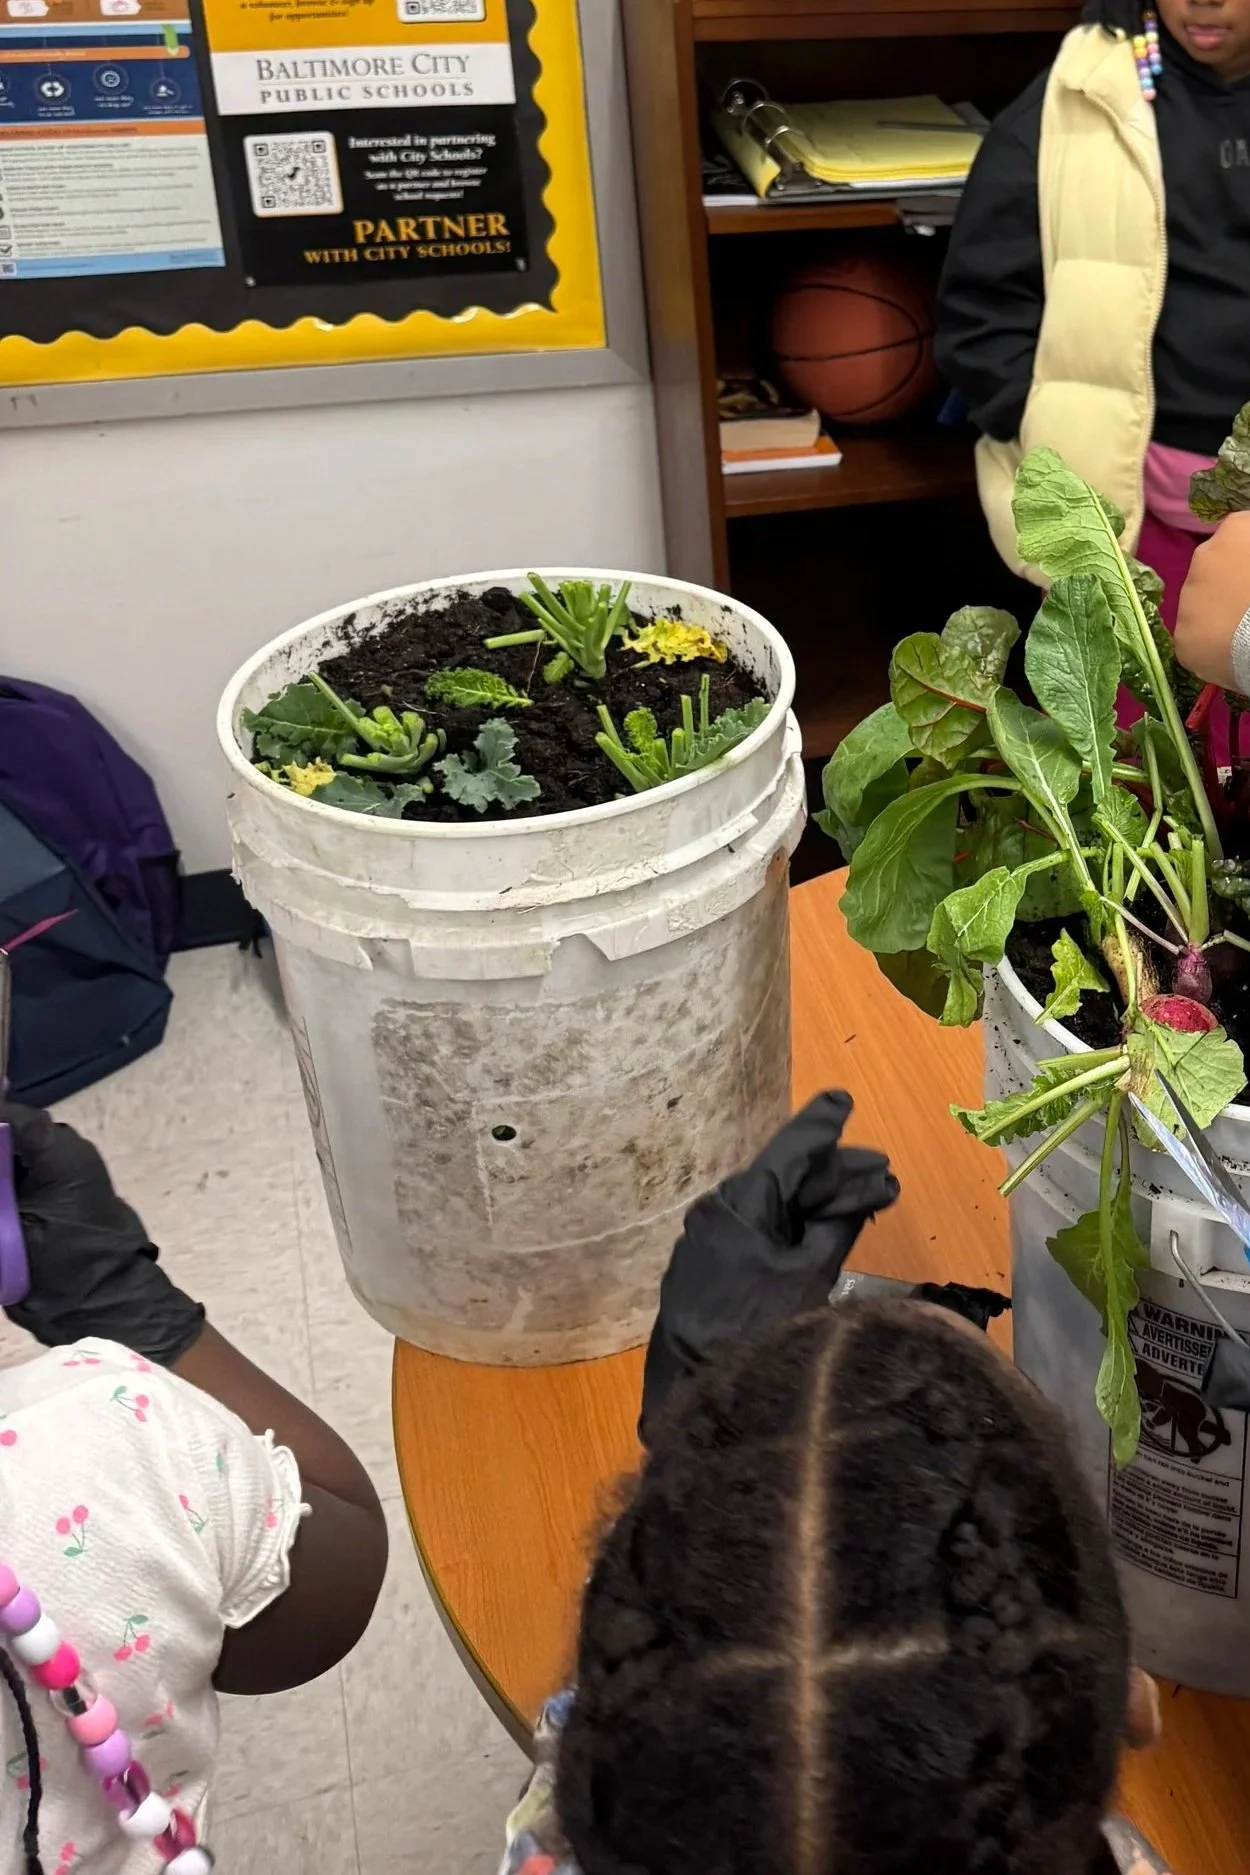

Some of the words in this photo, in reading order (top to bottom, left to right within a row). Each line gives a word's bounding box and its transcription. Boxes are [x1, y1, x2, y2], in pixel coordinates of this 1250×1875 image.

[255, 56, 403, 81] BALTIMORE
[411, 53, 471, 75] CITY
[260, 86, 351, 104] PUBLIC
[363, 82, 474, 99] SCHOOLS
[349, 135, 411, 149] Interested
[412, 134, 427, 146] in
[428, 132, 496, 149] partnering
[368, 149, 397, 163] with
[400, 150, 427, 164] City
[430, 147, 482, 162] Schools?
[353, 212, 510, 244] PARTNER
[303, 249, 358, 264] WITH
[363, 246, 411, 261] CITY
[416, 241, 511, 258] SCHOOLS!
[1144, 1302, 1222, 1342] WARNI
[1142, 1322, 1210, 1358] AVERTISSE
